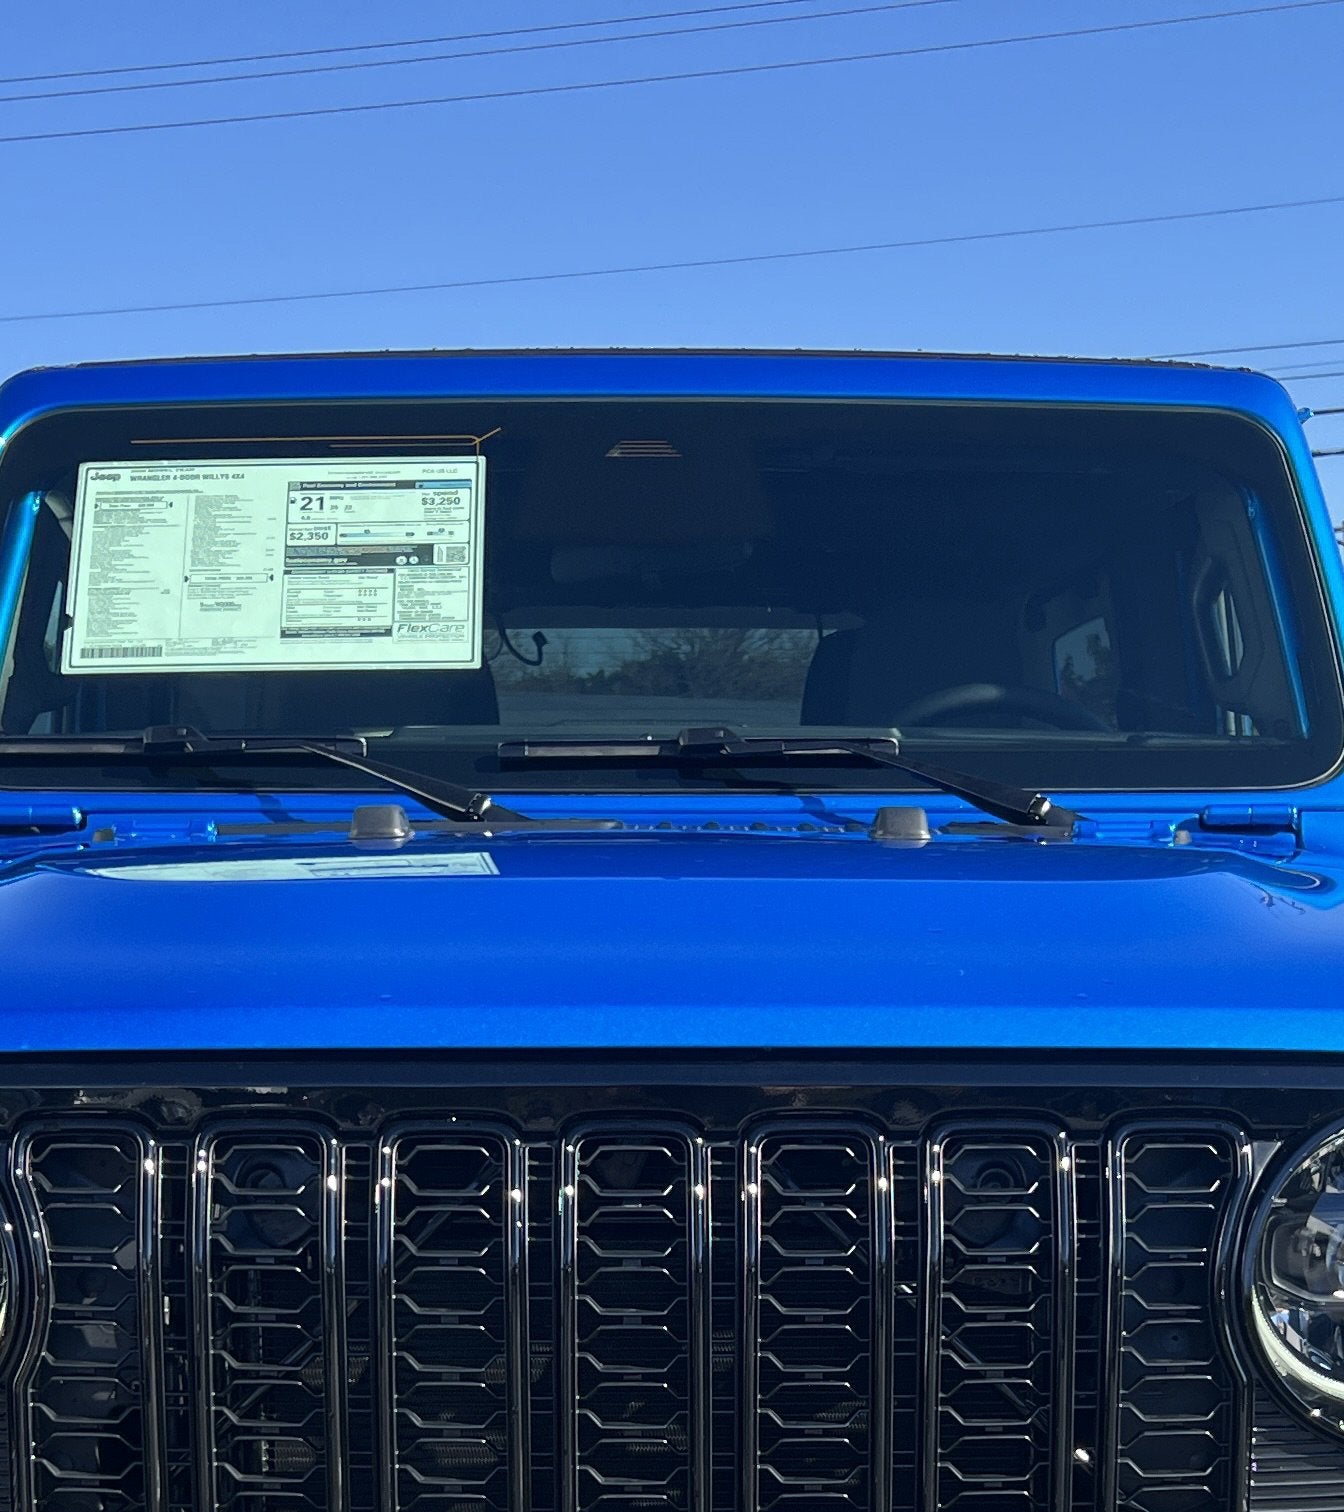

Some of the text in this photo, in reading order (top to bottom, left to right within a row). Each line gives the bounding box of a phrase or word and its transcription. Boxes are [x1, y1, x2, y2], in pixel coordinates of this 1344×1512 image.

[90, 472, 121, 482] Jeep
[130, 474, 171, 482] WRANGLER
[300, 496, 324, 511] 21
[421, 496, 461, 506] $3,250
[289, 532, 329, 541] $2,350
[397, 623, 465, 633] FlexCare
